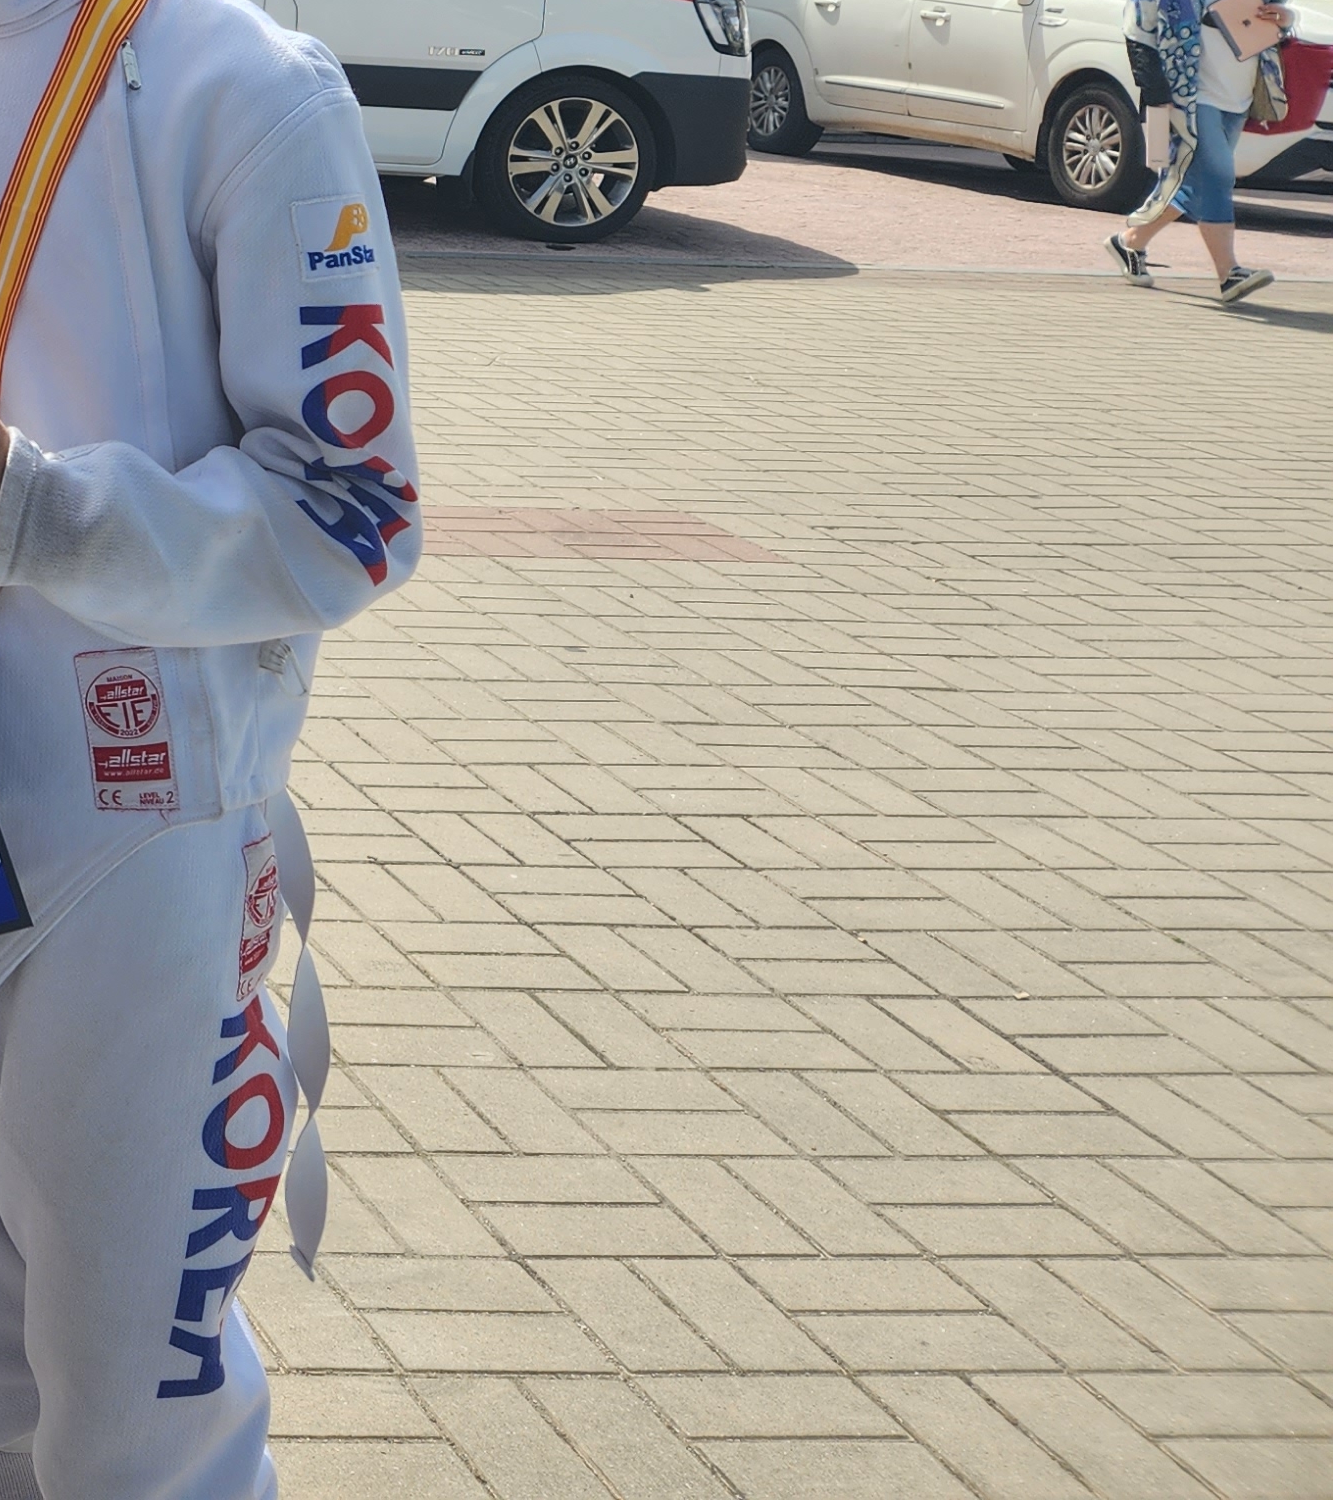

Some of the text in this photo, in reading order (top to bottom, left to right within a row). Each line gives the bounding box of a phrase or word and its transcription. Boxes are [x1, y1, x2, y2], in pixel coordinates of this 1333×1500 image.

[106, 674, 133, 683] MAISON
[106, 685, 145, 700] allstar
[120, 728, 139, 737] 2022
[108, 749, 167, 768] allstar
[98, 788, 123, 806] CE
[166, 791, 174, 804] 2
[156, 995, 285, 1399] KOREA
